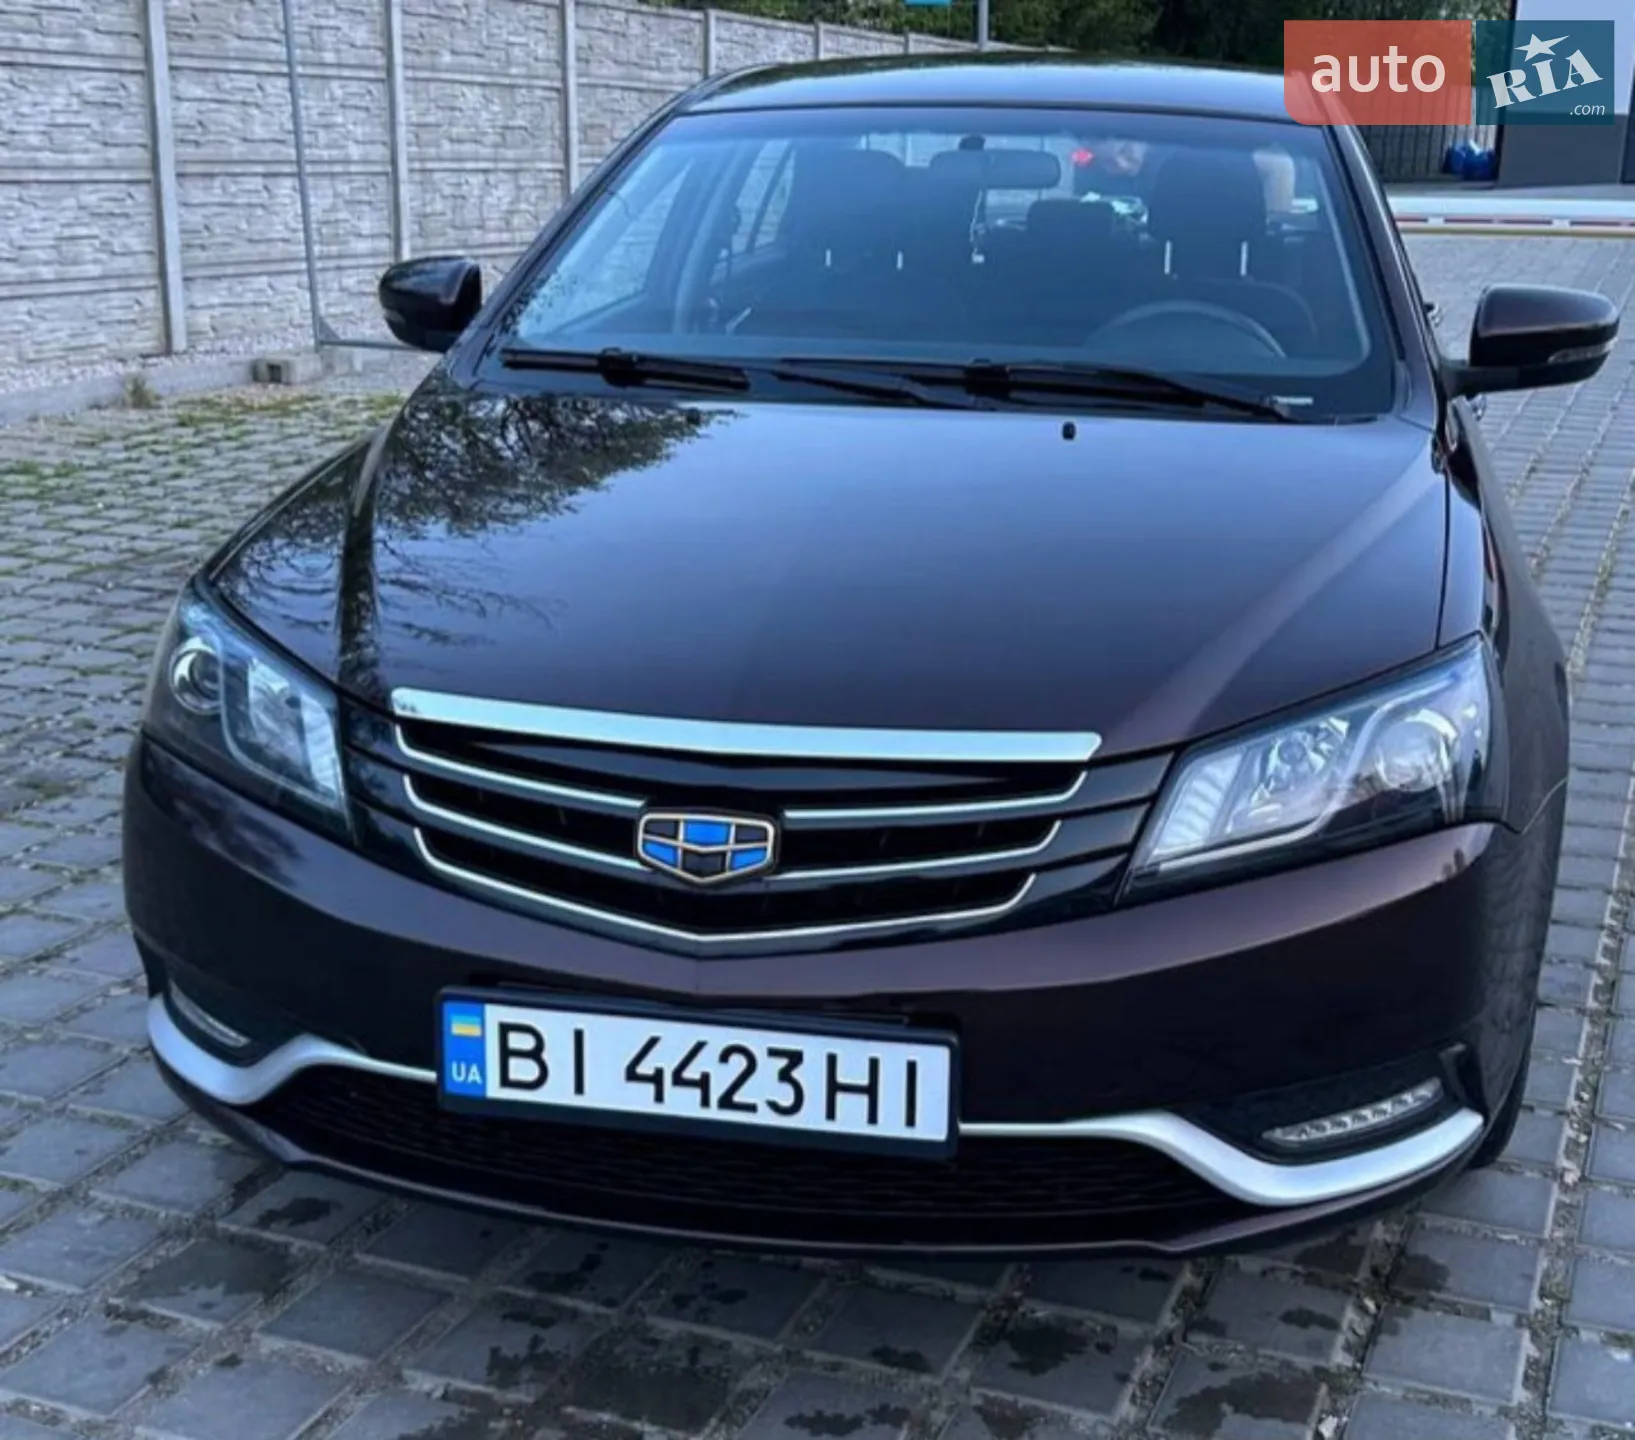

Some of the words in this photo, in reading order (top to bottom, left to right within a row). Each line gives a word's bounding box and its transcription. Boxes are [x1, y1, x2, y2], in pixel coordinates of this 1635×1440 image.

[451, 1061, 482, 1086] UA
[498, 1021, 585, 1096] BI
[624, 1035, 804, 1116] 4423
[825, 1052, 918, 1128] HI
